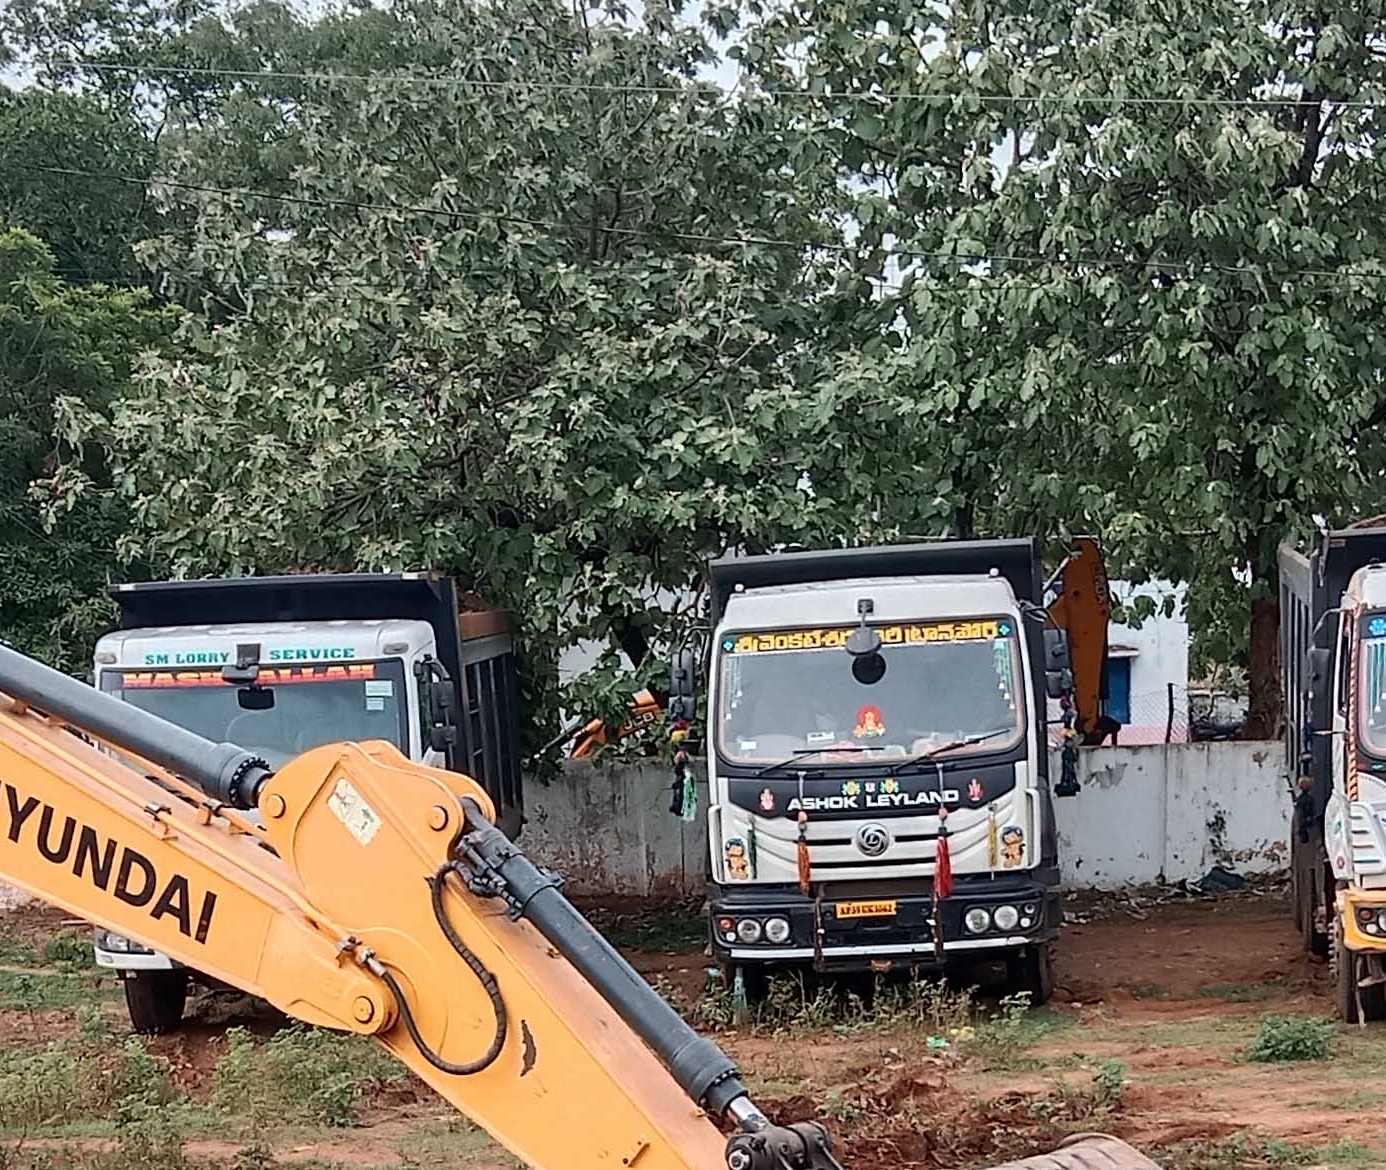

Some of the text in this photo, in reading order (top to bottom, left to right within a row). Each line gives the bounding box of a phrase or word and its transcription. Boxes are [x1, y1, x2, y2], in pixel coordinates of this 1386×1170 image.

[144, 647, 355, 665] SM LORRY SERVICE
[788, 789, 960, 812] ASHOK LEYLAND
